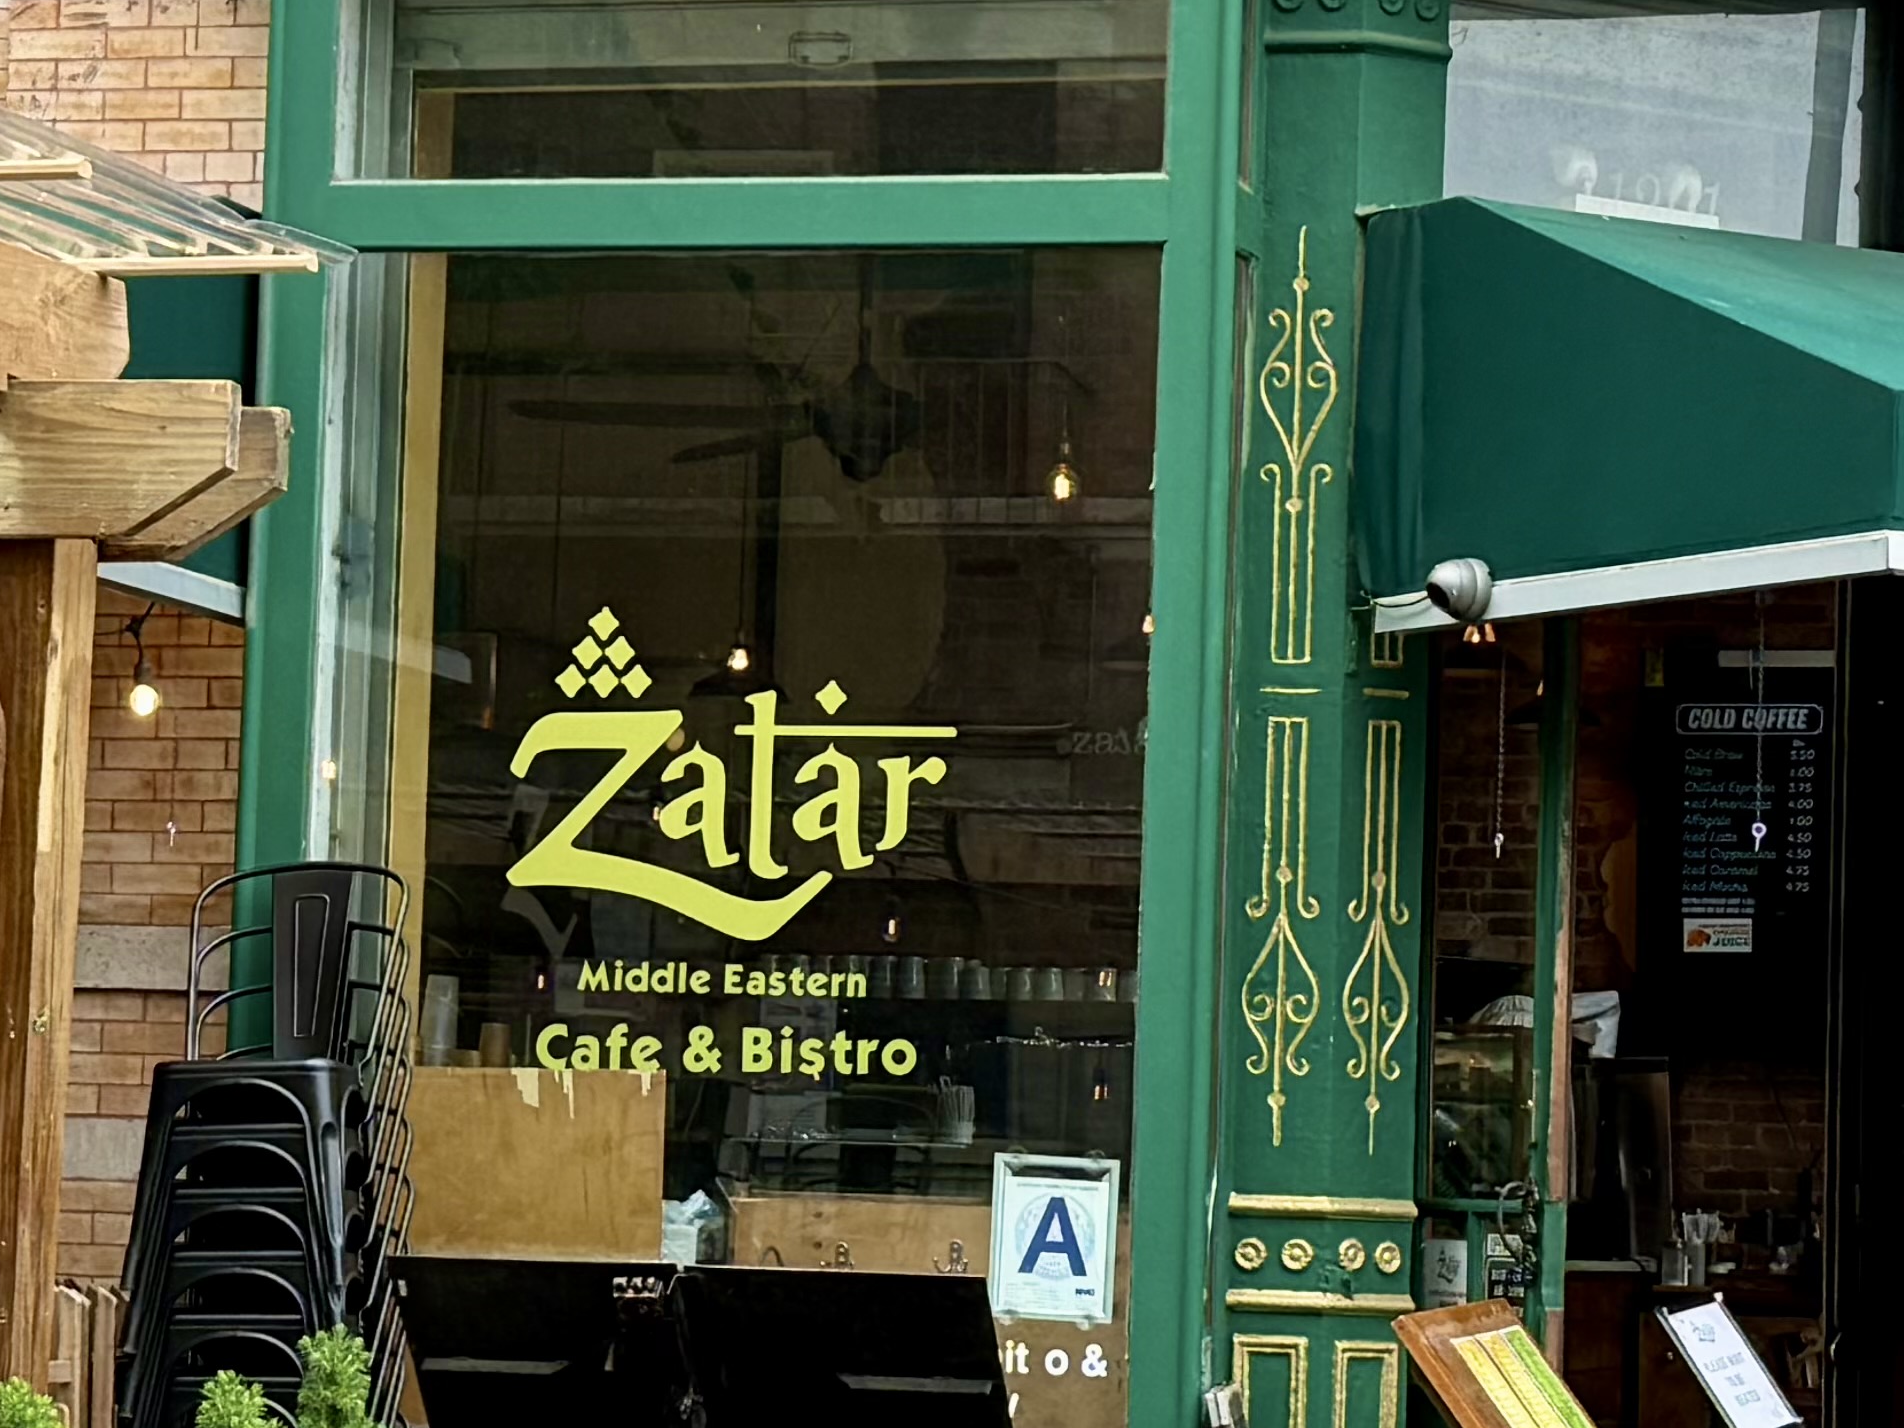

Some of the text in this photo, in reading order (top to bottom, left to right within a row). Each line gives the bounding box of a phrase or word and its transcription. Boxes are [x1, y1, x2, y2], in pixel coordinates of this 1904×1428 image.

[1687, 708, 1809, 730] COLD COFFEE
[506, 682, 957, 940] Zatar
[577, 959, 867, 999] Middle Eastern
[536, 1023, 918, 1080] Cafe & Bistro
[1017, 1196, 1088, 1277] A
[1081, 1343, 1108, 1378] &
